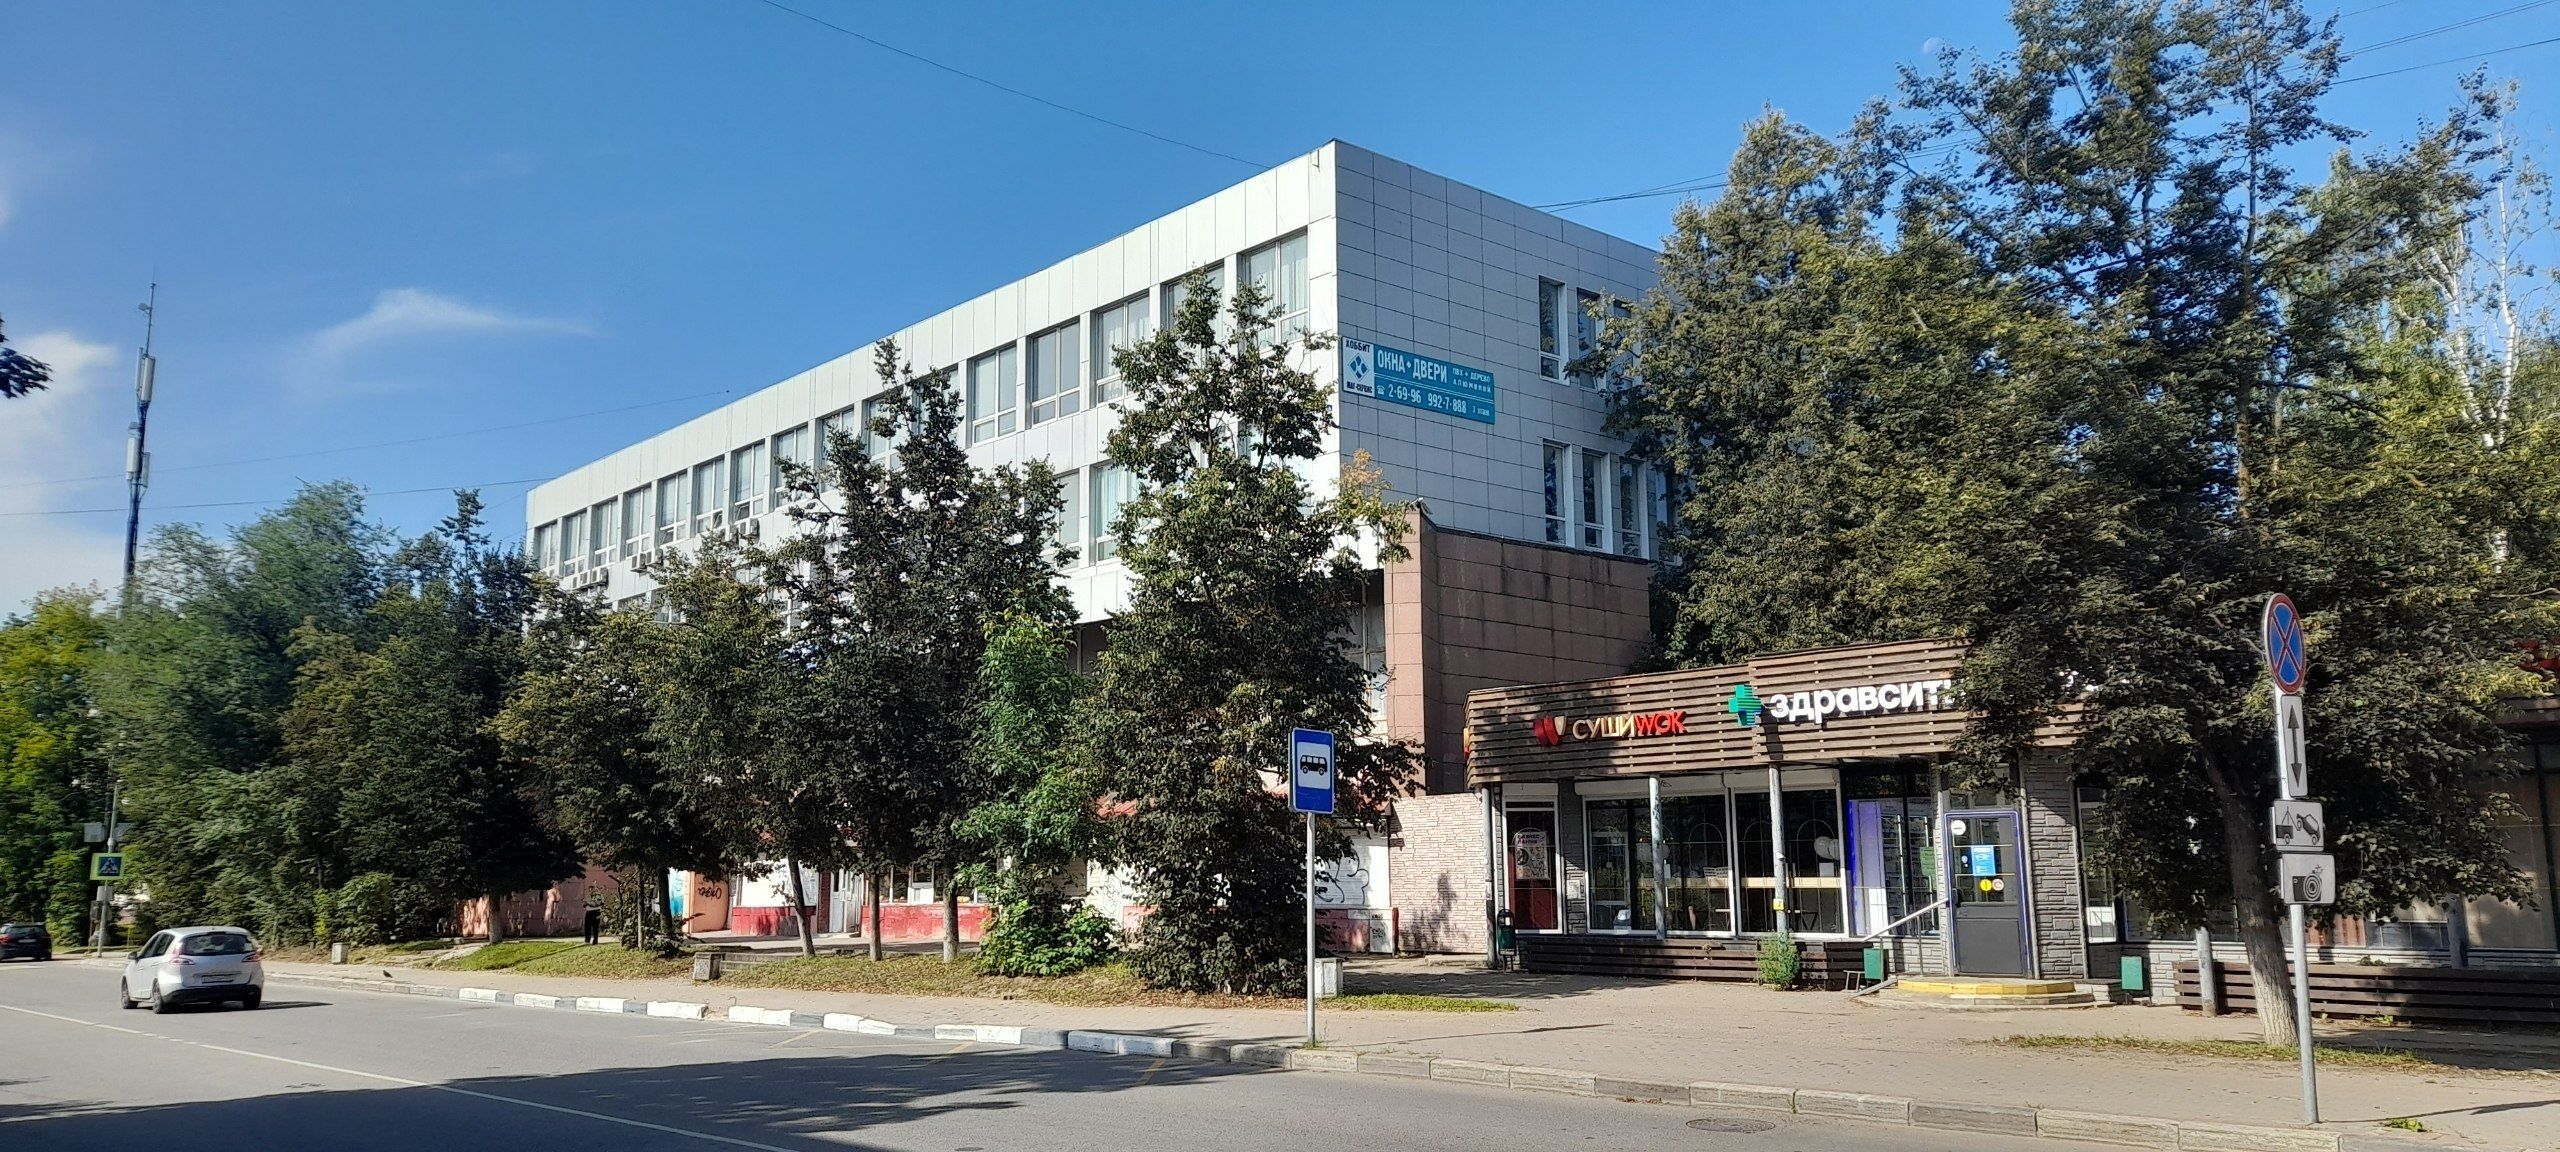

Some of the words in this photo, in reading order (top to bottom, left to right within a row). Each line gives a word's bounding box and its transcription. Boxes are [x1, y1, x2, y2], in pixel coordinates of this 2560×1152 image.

[1345, 340, 1370, 353] ХОББИТ
[1377, 350, 1405, 373] ОКНА
[1413, 358, 1447, 383] ДВЕРИ
[1470, 372, 1490, 383] ДЕРЕВО
[1388, 384, 1422, 404] 2-69-96
[1427, 393, 1467, 414] 992-7-888
